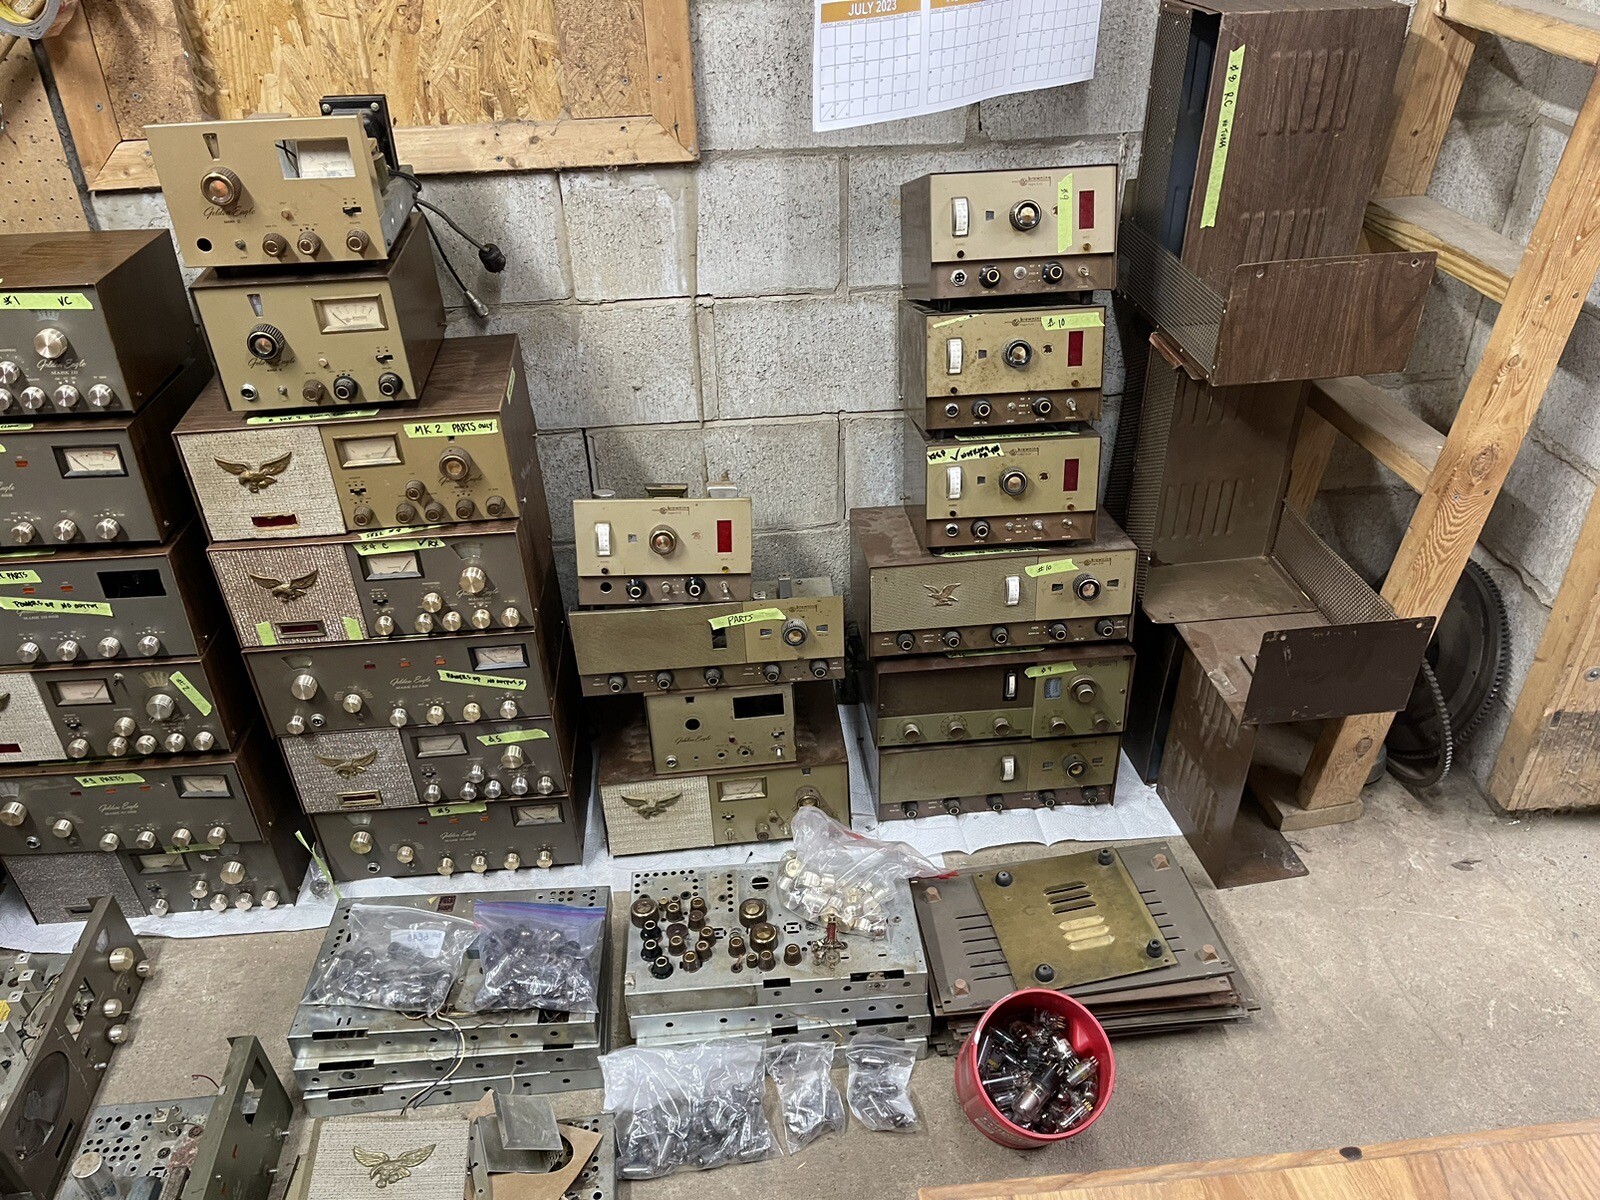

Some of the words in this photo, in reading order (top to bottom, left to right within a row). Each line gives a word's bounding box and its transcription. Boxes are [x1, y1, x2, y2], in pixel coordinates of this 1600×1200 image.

[848, 2, 874, 16] JULY
[876, 0, 897, 12] 2023
[233, 206, 256, 218] Eagle
[57, 296, 72, 306] VC
[64, 358, 86, 370] Eagle
[414, 424, 432, 435] MK
[435, 424, 442, 433] 2
[452, 422, 476, 433] PARTS
[6, 571, 28, 580] PARTS
[727, 614, 753, 626] PARTS
